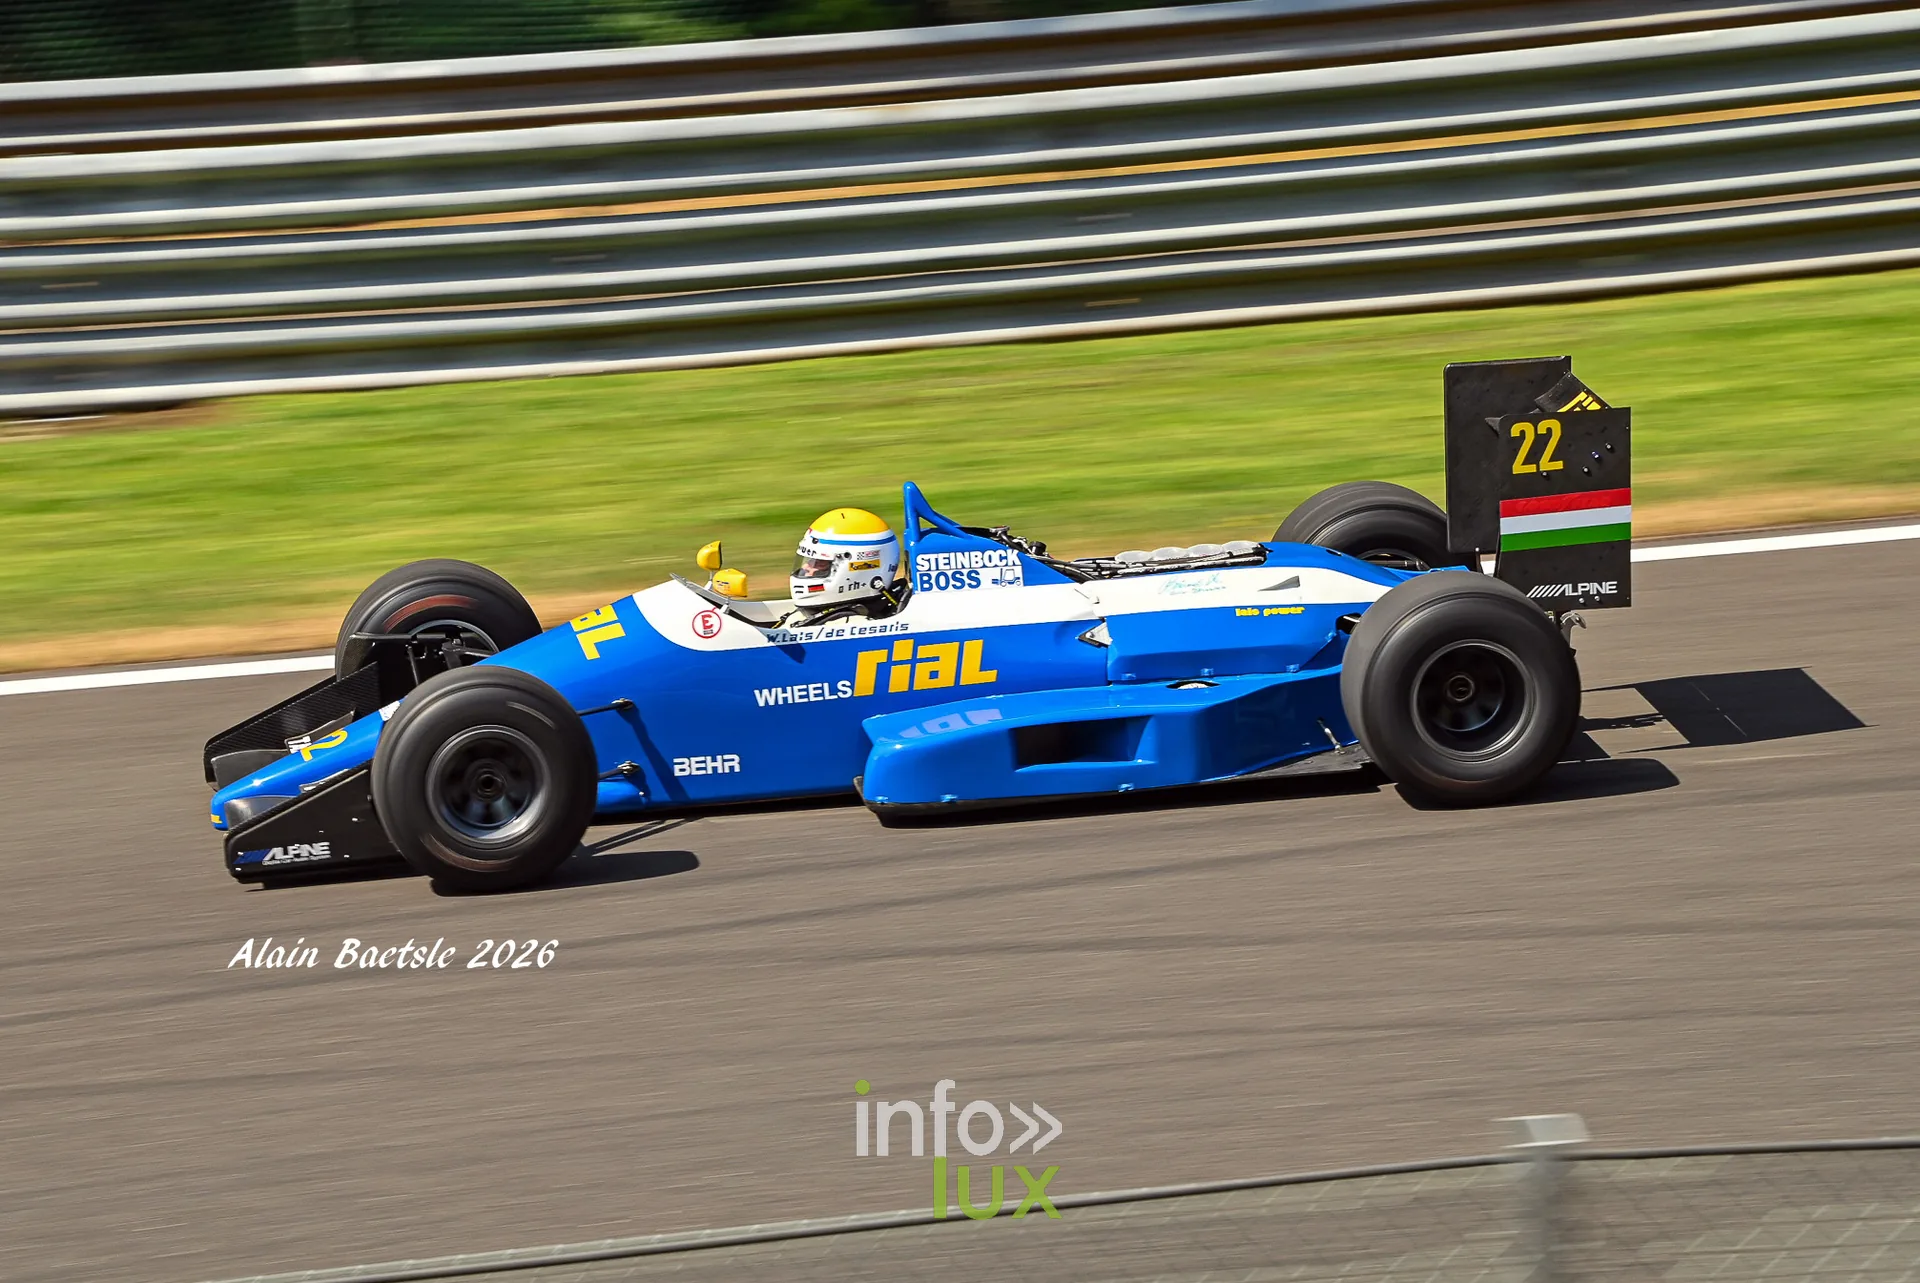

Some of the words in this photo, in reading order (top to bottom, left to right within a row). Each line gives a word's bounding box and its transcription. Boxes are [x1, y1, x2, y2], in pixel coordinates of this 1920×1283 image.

[1510, 418, 1564, 474] 22
[915, 548, 1022, 571] STEINBOCK
[918, 569, 982, 592] BOSS
[1553, 581, 1618, 596] ALPINE
[701, 614, 714, 630] E
[753, 680, 852, 706] WHEELS
[672, 754, 741, 777] BEHR
